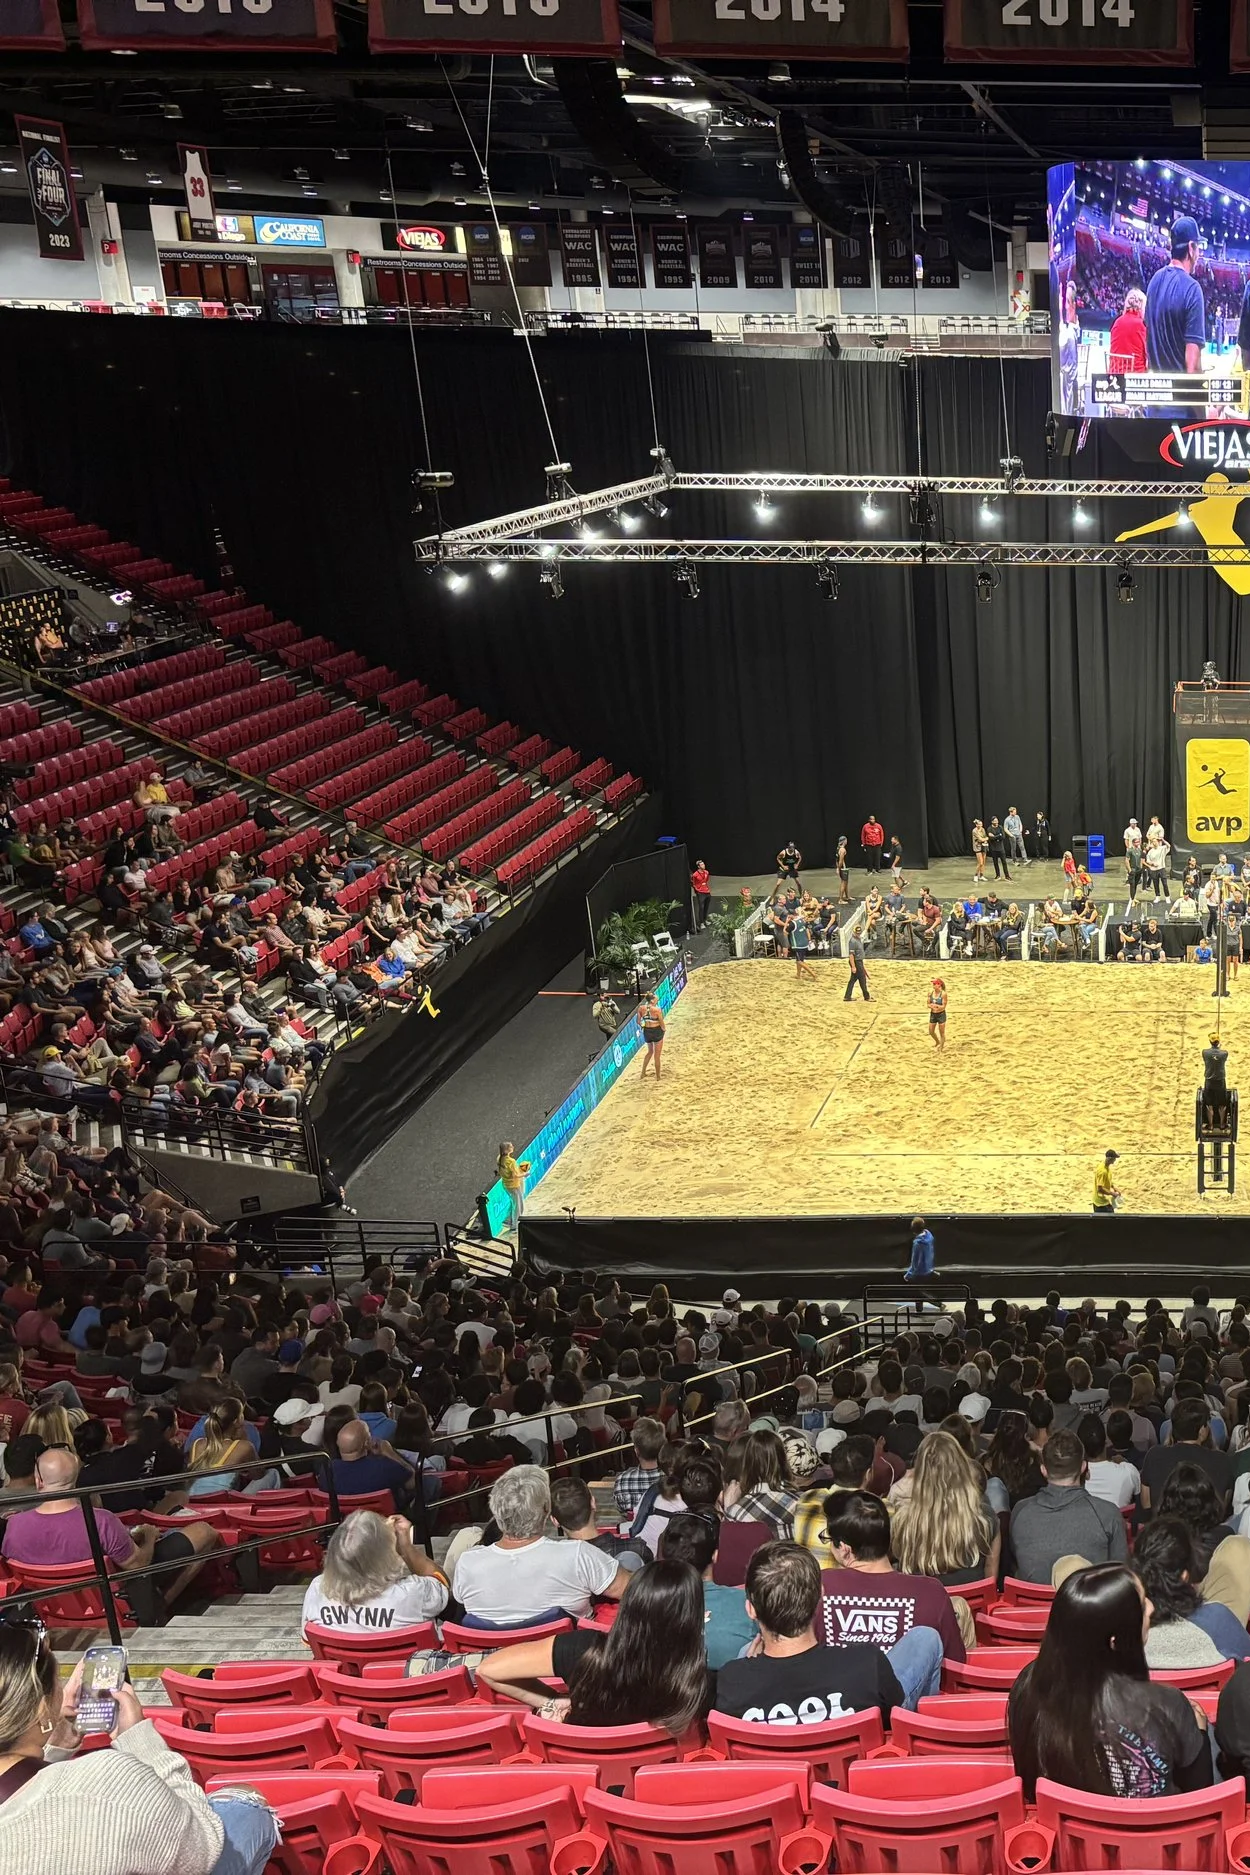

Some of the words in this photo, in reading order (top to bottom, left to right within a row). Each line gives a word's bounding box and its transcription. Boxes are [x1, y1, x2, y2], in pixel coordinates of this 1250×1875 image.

[1001, 0, 1135, 27] 2014
[37, 167, 62, 187] FINAL
[190, 176, 205, 198] 33
[41, 186, 66, 204] FOUR
[274, 222, 319, 234] CALIFORNIA
[49, 233, 71, 248] 2023
[223, 232, 246, 242] Diego
[280, 231, 306, 241] COAST
[400, 229, 440, 248] VIEJAS
[565, 242, 592, 250] WAC
[610, 243, 637, 251] WAC
[657, 243, 684, 251] WAC
[182, 251, 224, 260] Concessions
[367, 258, 402, 266] Restrooms
[402, 260, 442, 268] Concessions
[443, 261, 467, 269] Outside
[664, 275, 683, 283] 1995
[707, 276, 730, 284] 2009
[754, 276, 774, 284] 2010
[799, 276, 819, 284] 2010
[842, 276, 862, 284] 2012
[888, 276, 910, 284] 2012
[930, 276, 951, 284] 2013
[1095, 392, 1122, 402] LEAGUE
[1195, 816, 1243, 836] avp
[320, 1605, 395, 1628] GWYNN
[835, 1608, 900, 1634] VANS
[838, 1632, 869, 1643] Since
[870, 1633, 897, 1643] 1966
